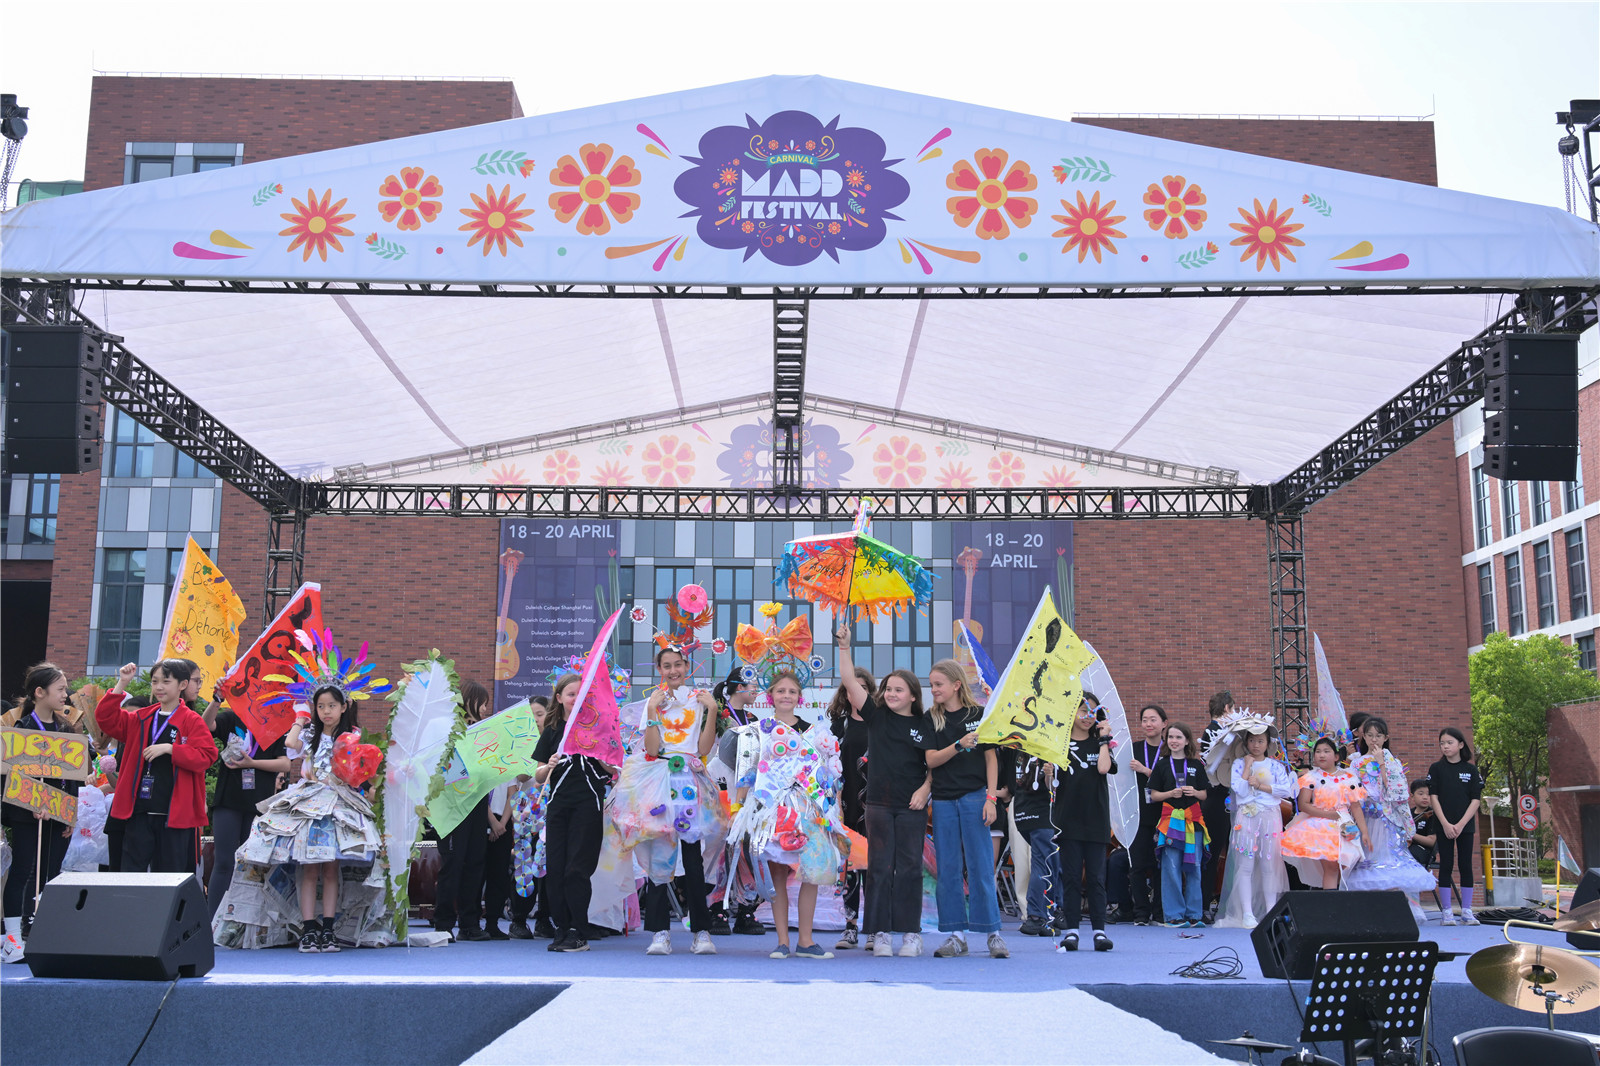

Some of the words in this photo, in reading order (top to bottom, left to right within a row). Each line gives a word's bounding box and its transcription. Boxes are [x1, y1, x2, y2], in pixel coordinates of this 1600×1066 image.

[769, 155, 814, 165] CARNIVAL
[742, 168, 843, 197] MADD
[742, 201, 843, 220] FESTIVAL
[509, 525, 527, 538] 18
[545, 524, 564, 538] 20
[569, 525, 614, 538] APRIL
[986, 534, 1004, 546] 18
[1023, 534, 1043, 547] 20
[990, 554, 1038, 568] APRIL
[1525, 799, 1532, 809] 5
